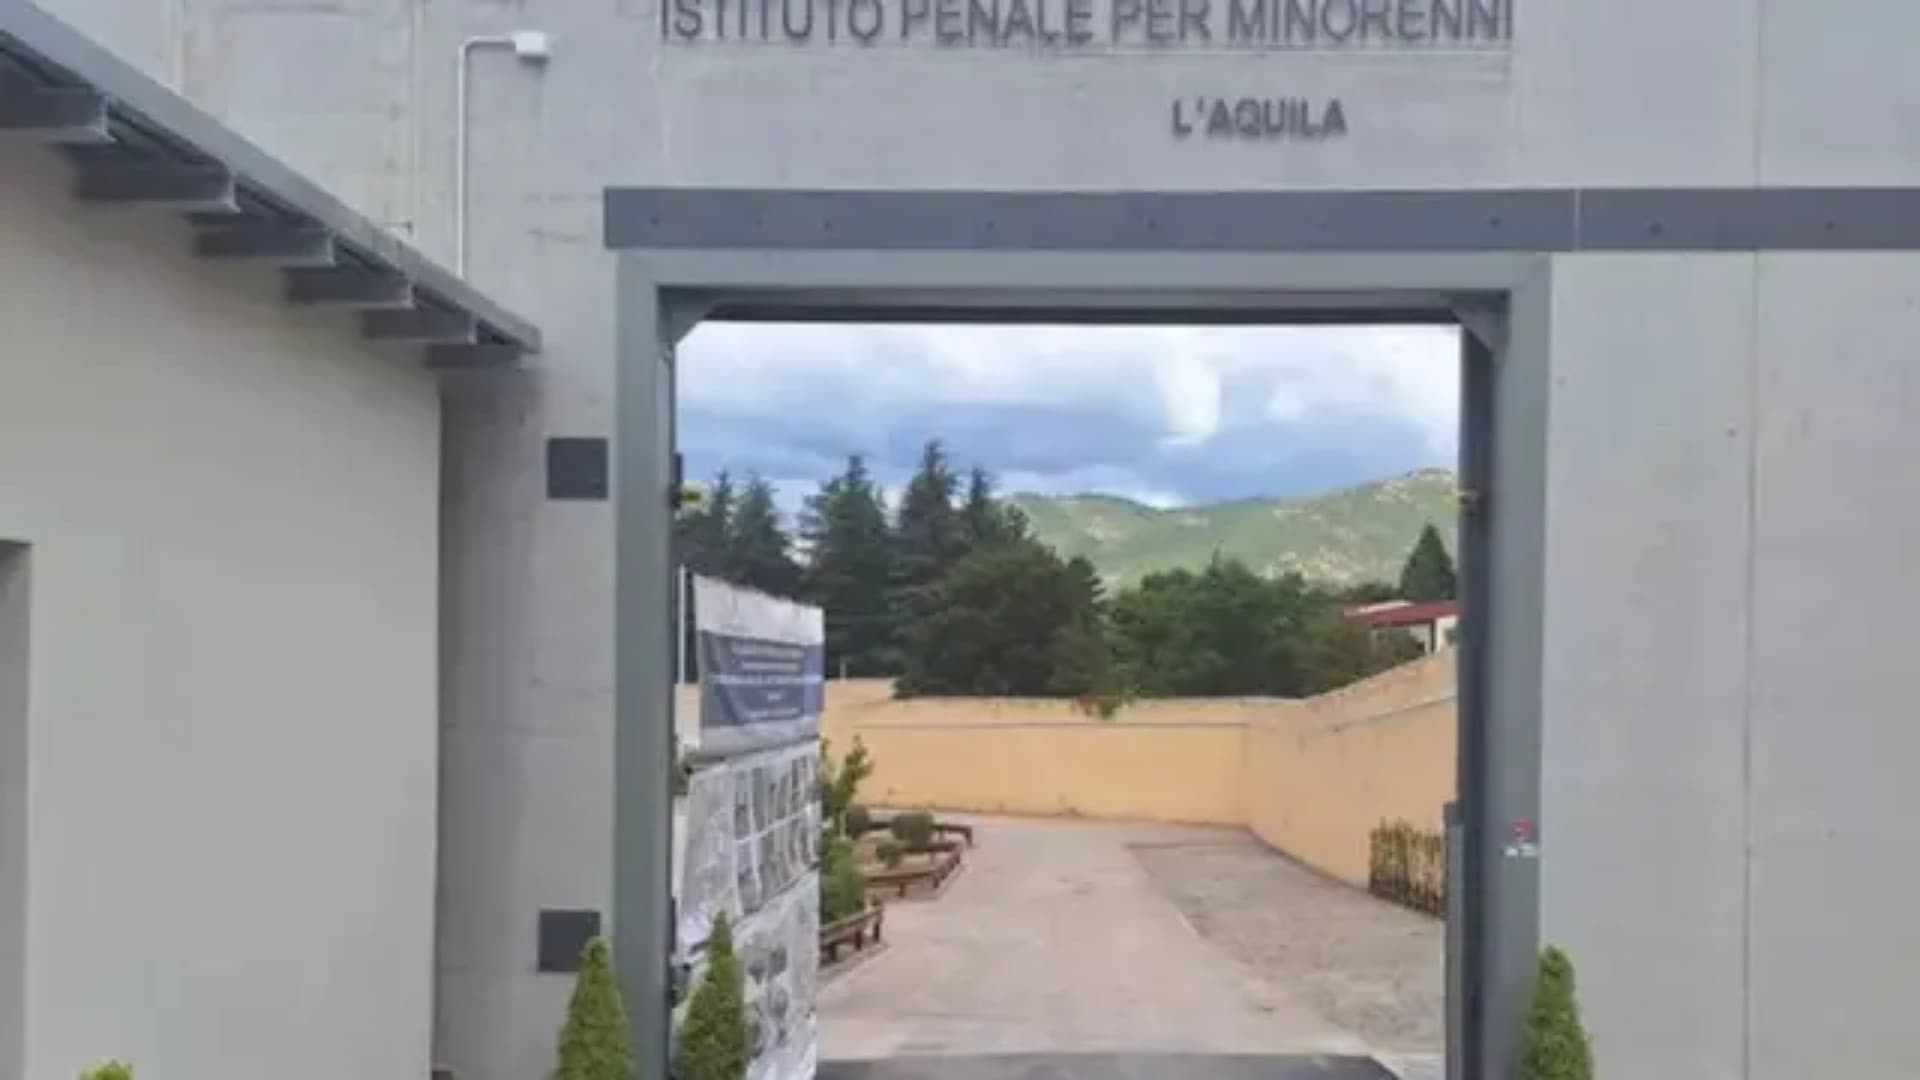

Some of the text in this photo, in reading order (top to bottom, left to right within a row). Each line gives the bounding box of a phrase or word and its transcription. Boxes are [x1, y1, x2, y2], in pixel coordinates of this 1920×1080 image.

[660, 0, 1514, 45] ISTITUTO PENALE PER MINORENNI
[1171, 97, 1348, 138] L'AQUILA
